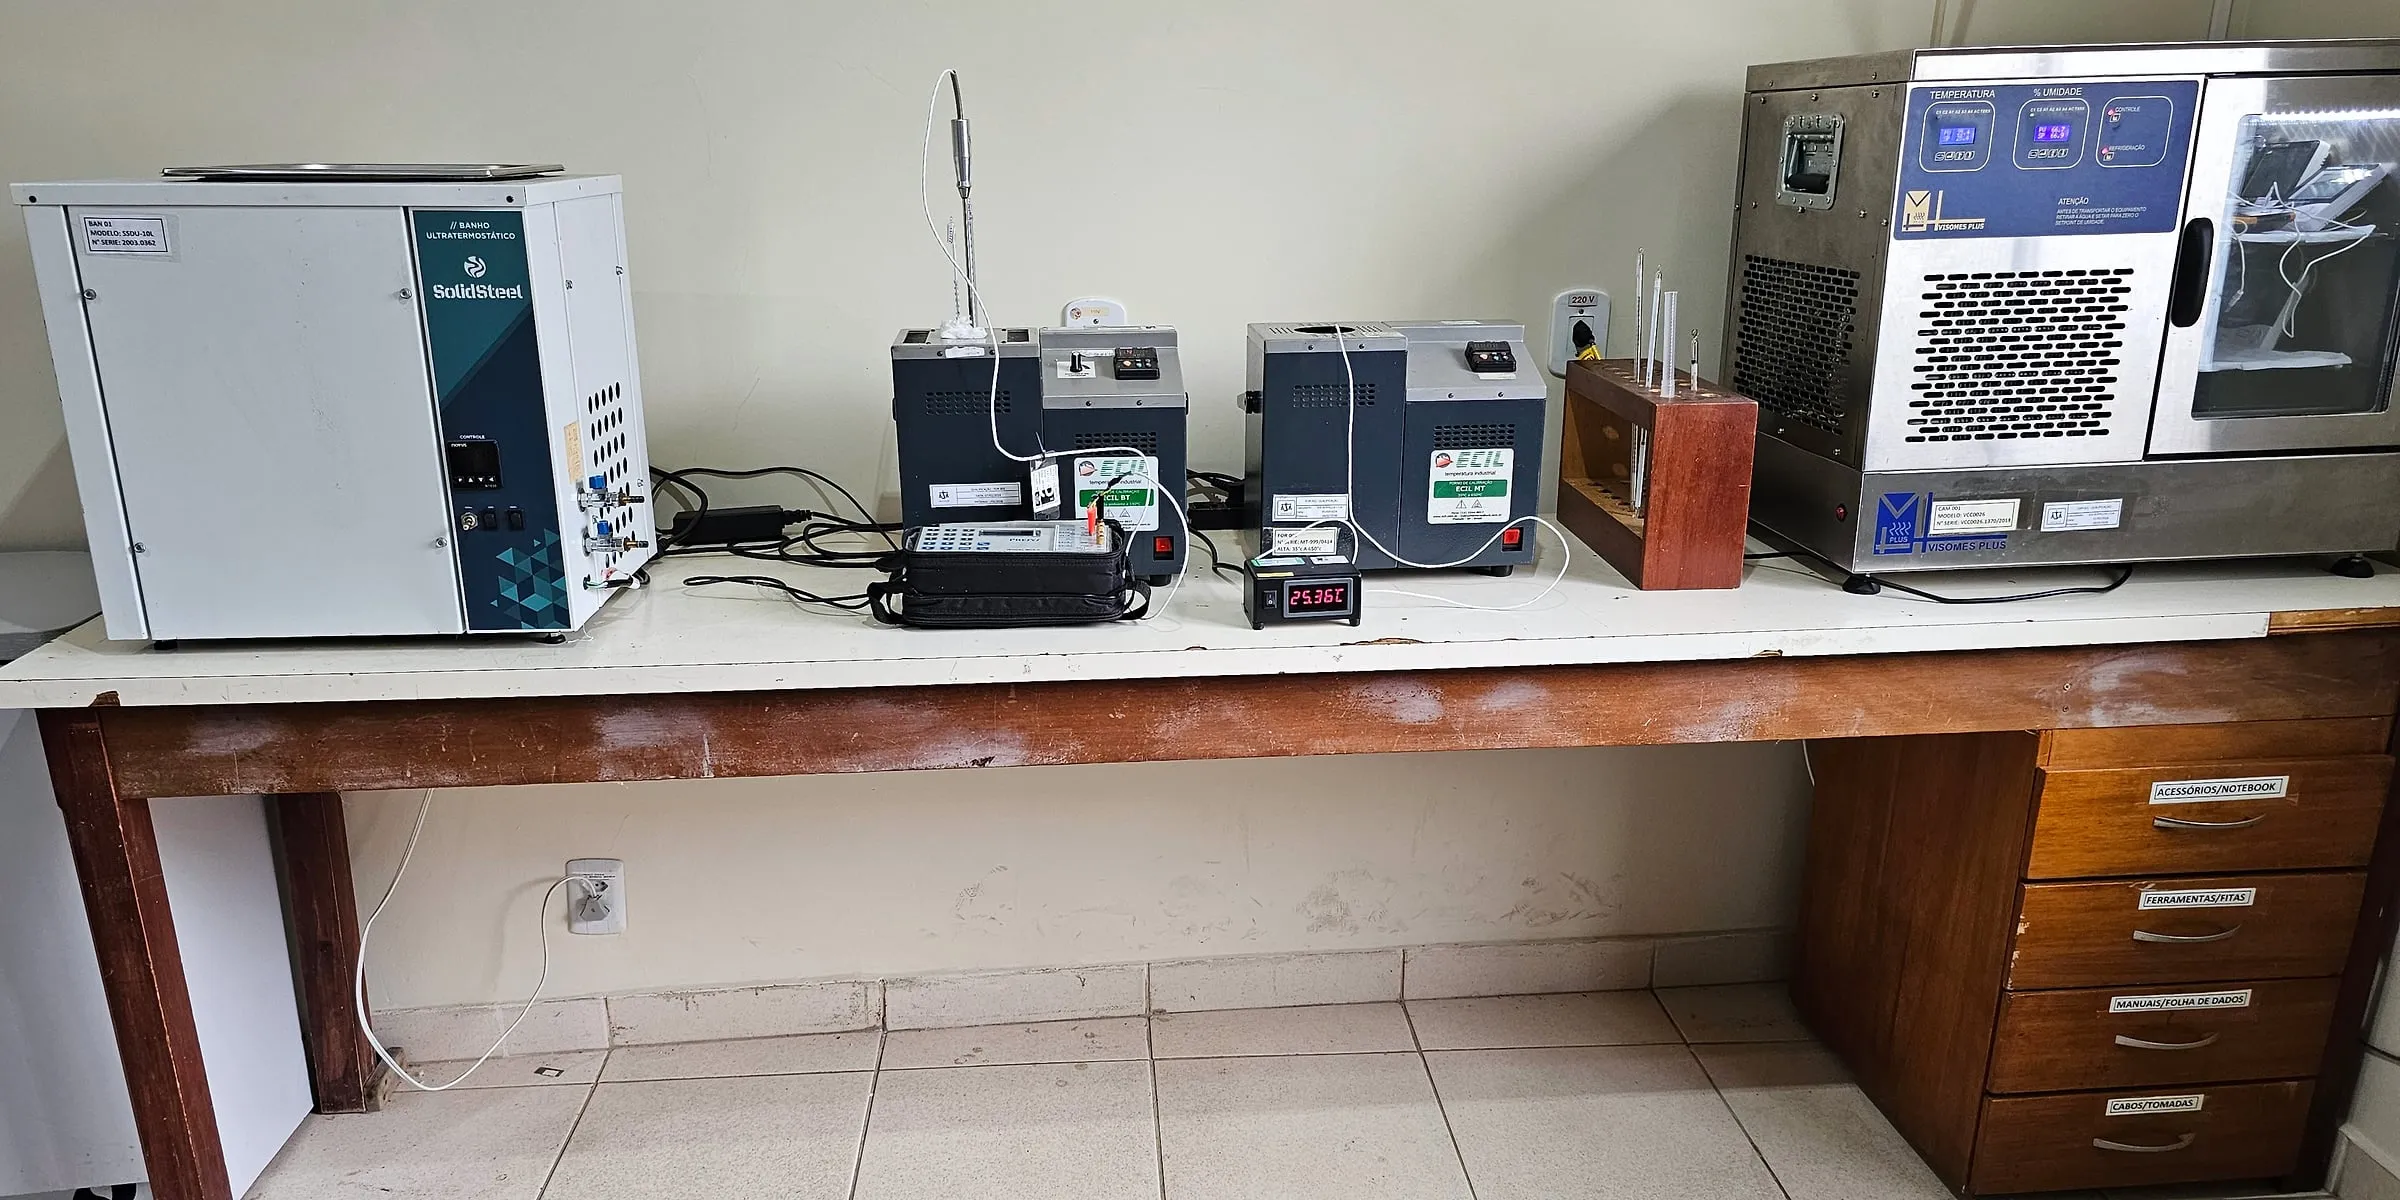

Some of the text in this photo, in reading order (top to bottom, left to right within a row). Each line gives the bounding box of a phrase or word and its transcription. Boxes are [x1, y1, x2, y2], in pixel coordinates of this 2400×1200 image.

[1929, 89, 1995, 99] TEMPERATURA
[2033, 87, 2082, 96] % UMIDADE
[2058, 196, 2089, 206] ATENÇÃO
[1967, 222, 1985, 230] PLUS
[426, 231, 516, 239] ULTRATERMOSTÁTICO
[433, 283, 523, 299] SolidSteel
[1572, 295, 1595, 304] 220 V
[1456, 450, 1504, 468] ECIL
[1100, 459, 1149, 477] ECIL
[1928, 541, 2007, 552] VISOMES PLUS
[2157, 782, 2277, 797] ACESSÓRIOS/NOTEBOOK
[2146, 893, 2246, 905] FERRAMENTAS/FITAS
[2116, 995, 2244, 1009] MANUAIS/FOLHA DE DADOS
[2112, 1099, 2194, 1111] CABOS/TOMADAS
